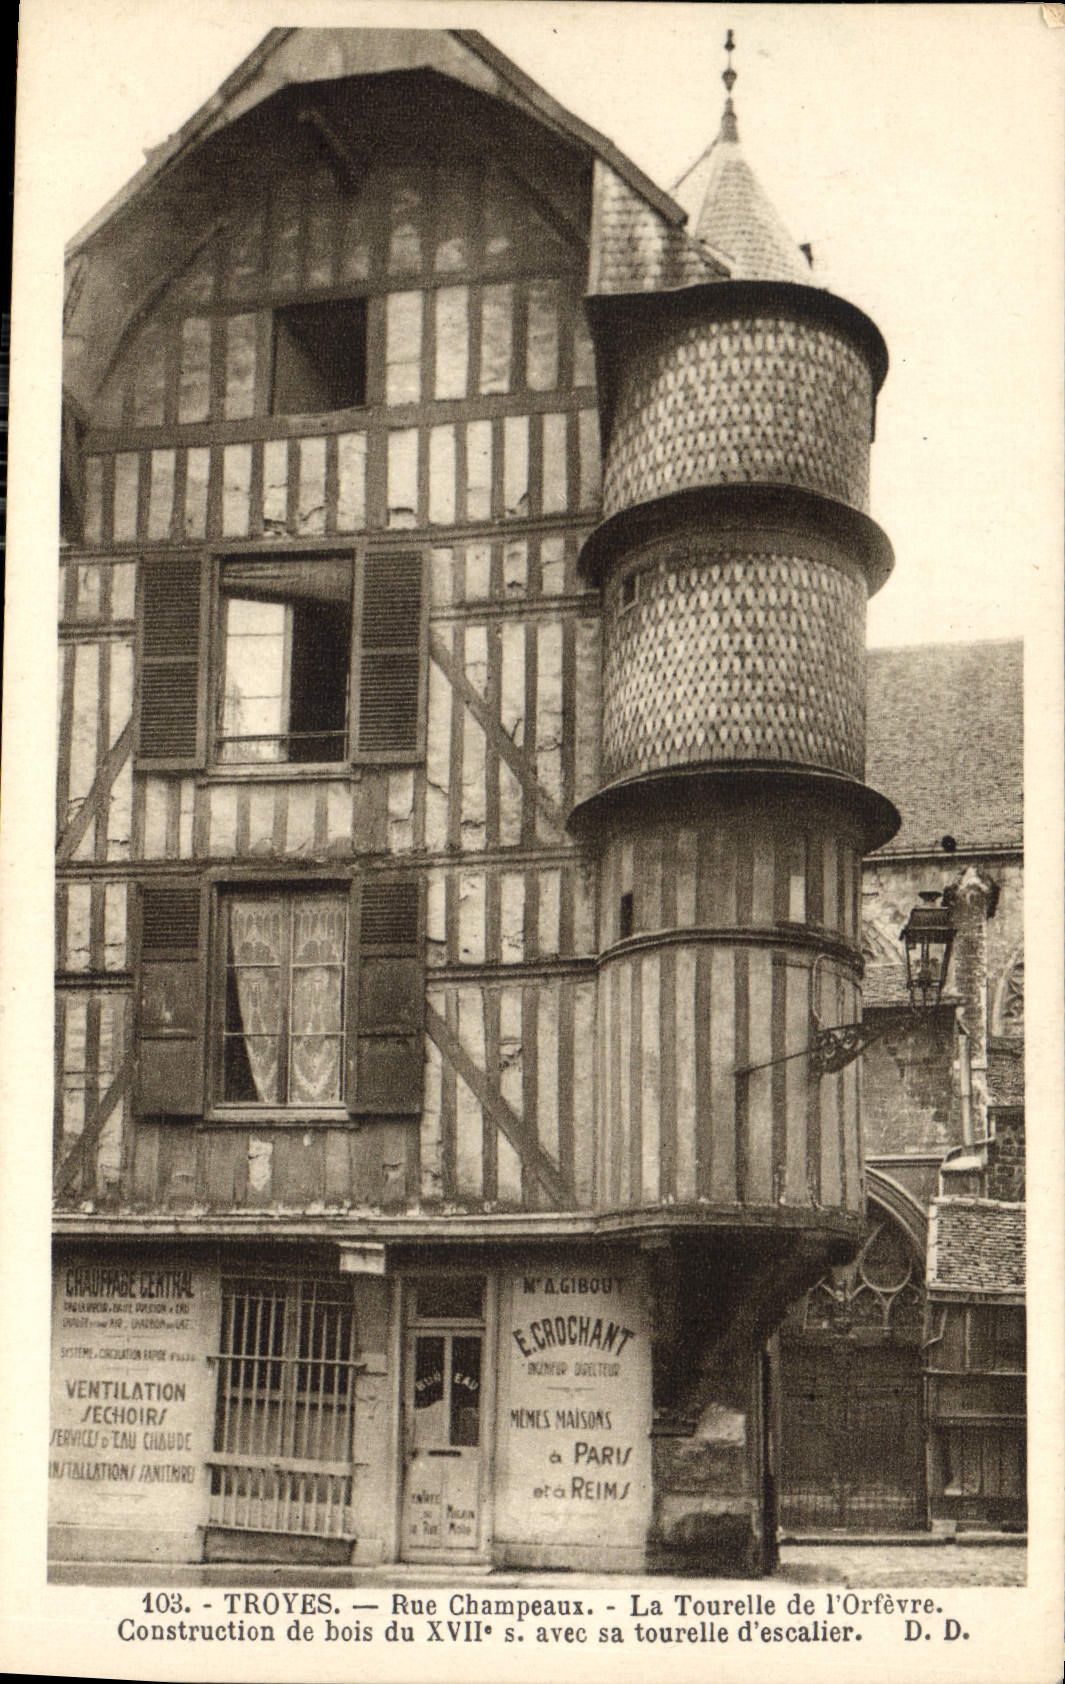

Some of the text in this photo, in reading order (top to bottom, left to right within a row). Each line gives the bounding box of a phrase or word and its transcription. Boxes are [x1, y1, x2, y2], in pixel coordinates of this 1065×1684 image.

[65, 1268, 136, 1298] CHAUFFAGE
[65, 1379, 186, 1402] VENTILATION
[81, 1405, 168, 1426] SECHOIRS
[49, 1428, 100, 1449] SERVICES
[143, 1431, 192, 1451] CHAUDE
[574, 1442, 632, 1465] PARIS
[571, 1476, 631, 1500] REIMS
